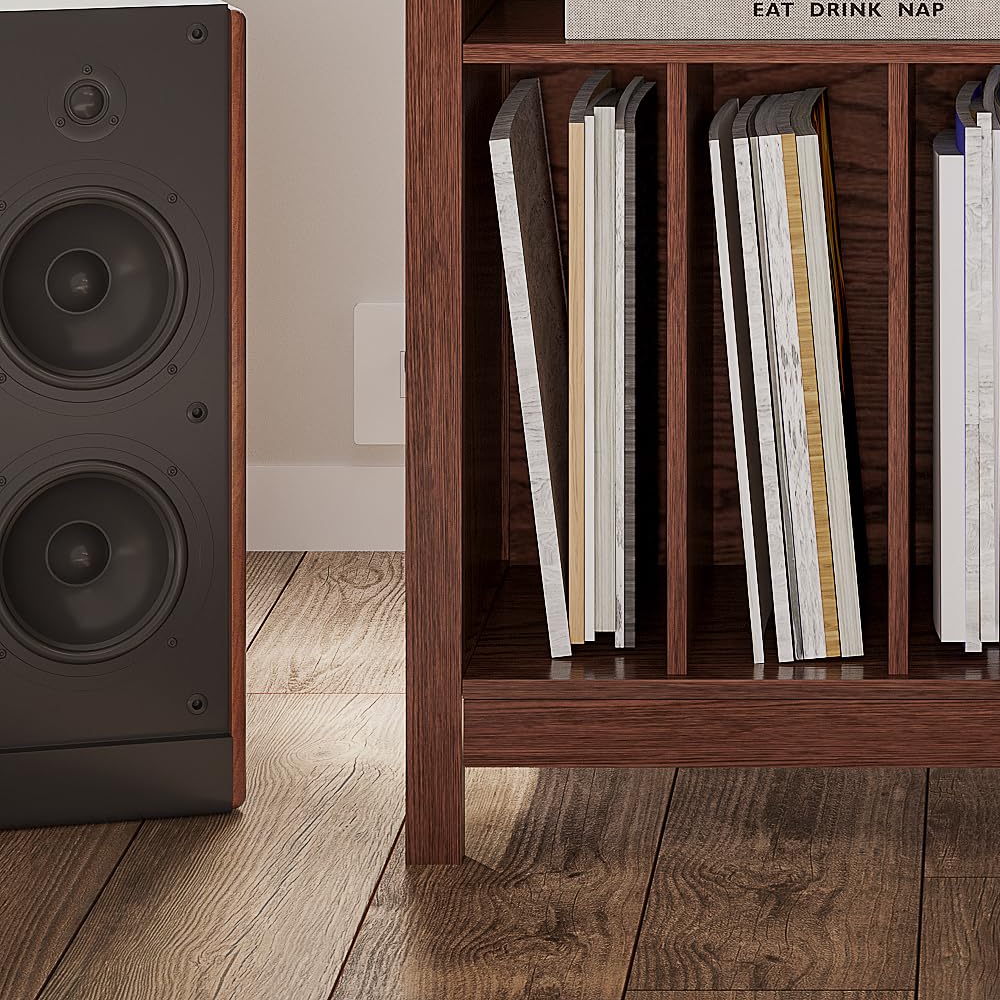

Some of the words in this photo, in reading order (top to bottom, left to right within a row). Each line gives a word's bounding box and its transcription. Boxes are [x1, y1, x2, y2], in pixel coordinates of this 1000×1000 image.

[753, 2, 794, 17] EAT
[810, 2, 882, 17] DRINK
[899, 2, 944, 17] NAP
